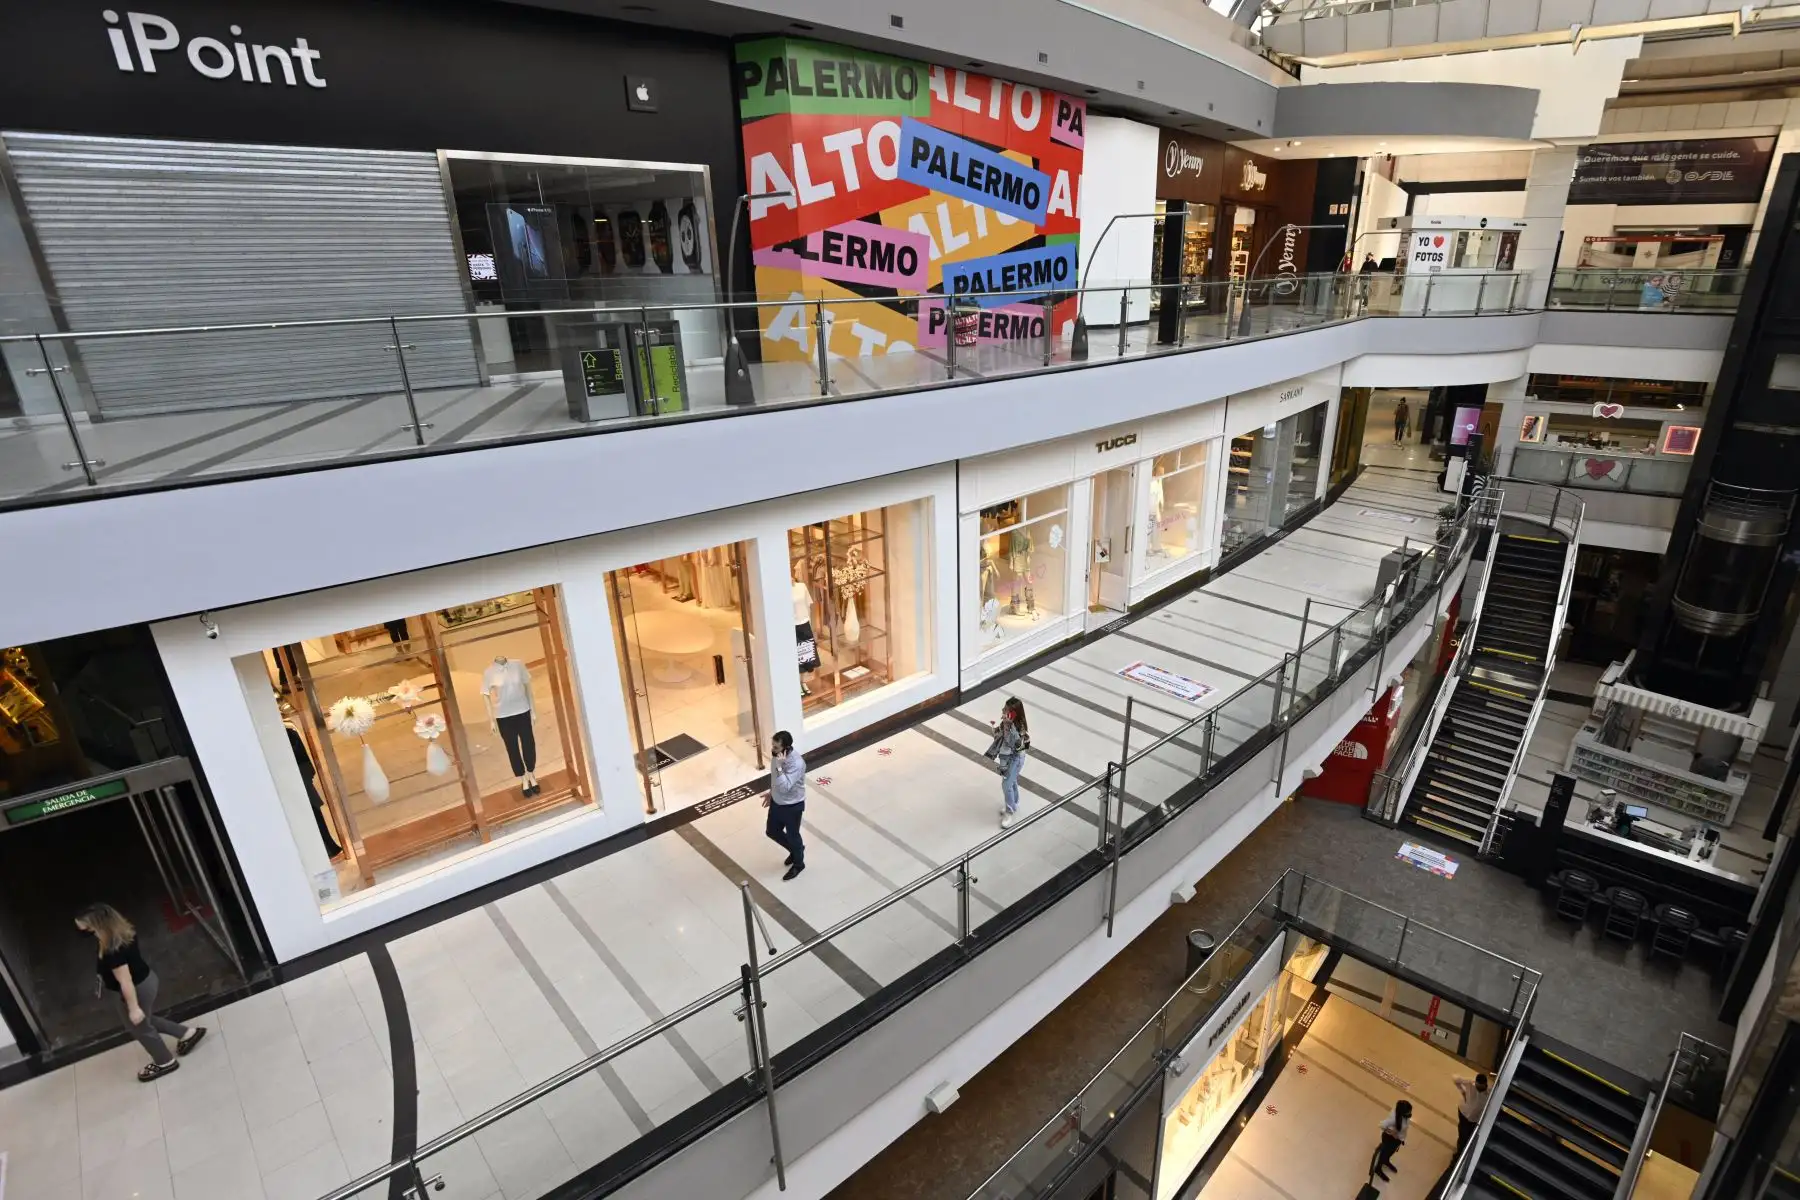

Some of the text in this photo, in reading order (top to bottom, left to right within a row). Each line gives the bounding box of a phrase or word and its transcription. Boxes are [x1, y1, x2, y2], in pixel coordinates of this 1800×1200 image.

[102, 9, 327, 88] iPoint
[737, 56, 918, 101] PALERMO
[750, 120, 901, 221] ALTO
[910, 136, 1040, 210] PALERMO
[1177, 147, 1203, 177] Yenny
[1278, 223, 1302, 273] Yenny
[1415, 252, 1444, 262] FOTOS
[1417, 236, 1431, 247] YO
[953, 256, 1068, 303] PALERMO
[764, 291, 917, 365] ALT
[613, 349, 624, 380] Basura
[668, 346, 681, 393] Reciclable
[1095, 433, 1137, 454] TUCCI
[42, 794, 96, 814] EMERGENCIA
[44, 789, 88, 806] SALIDA DE
